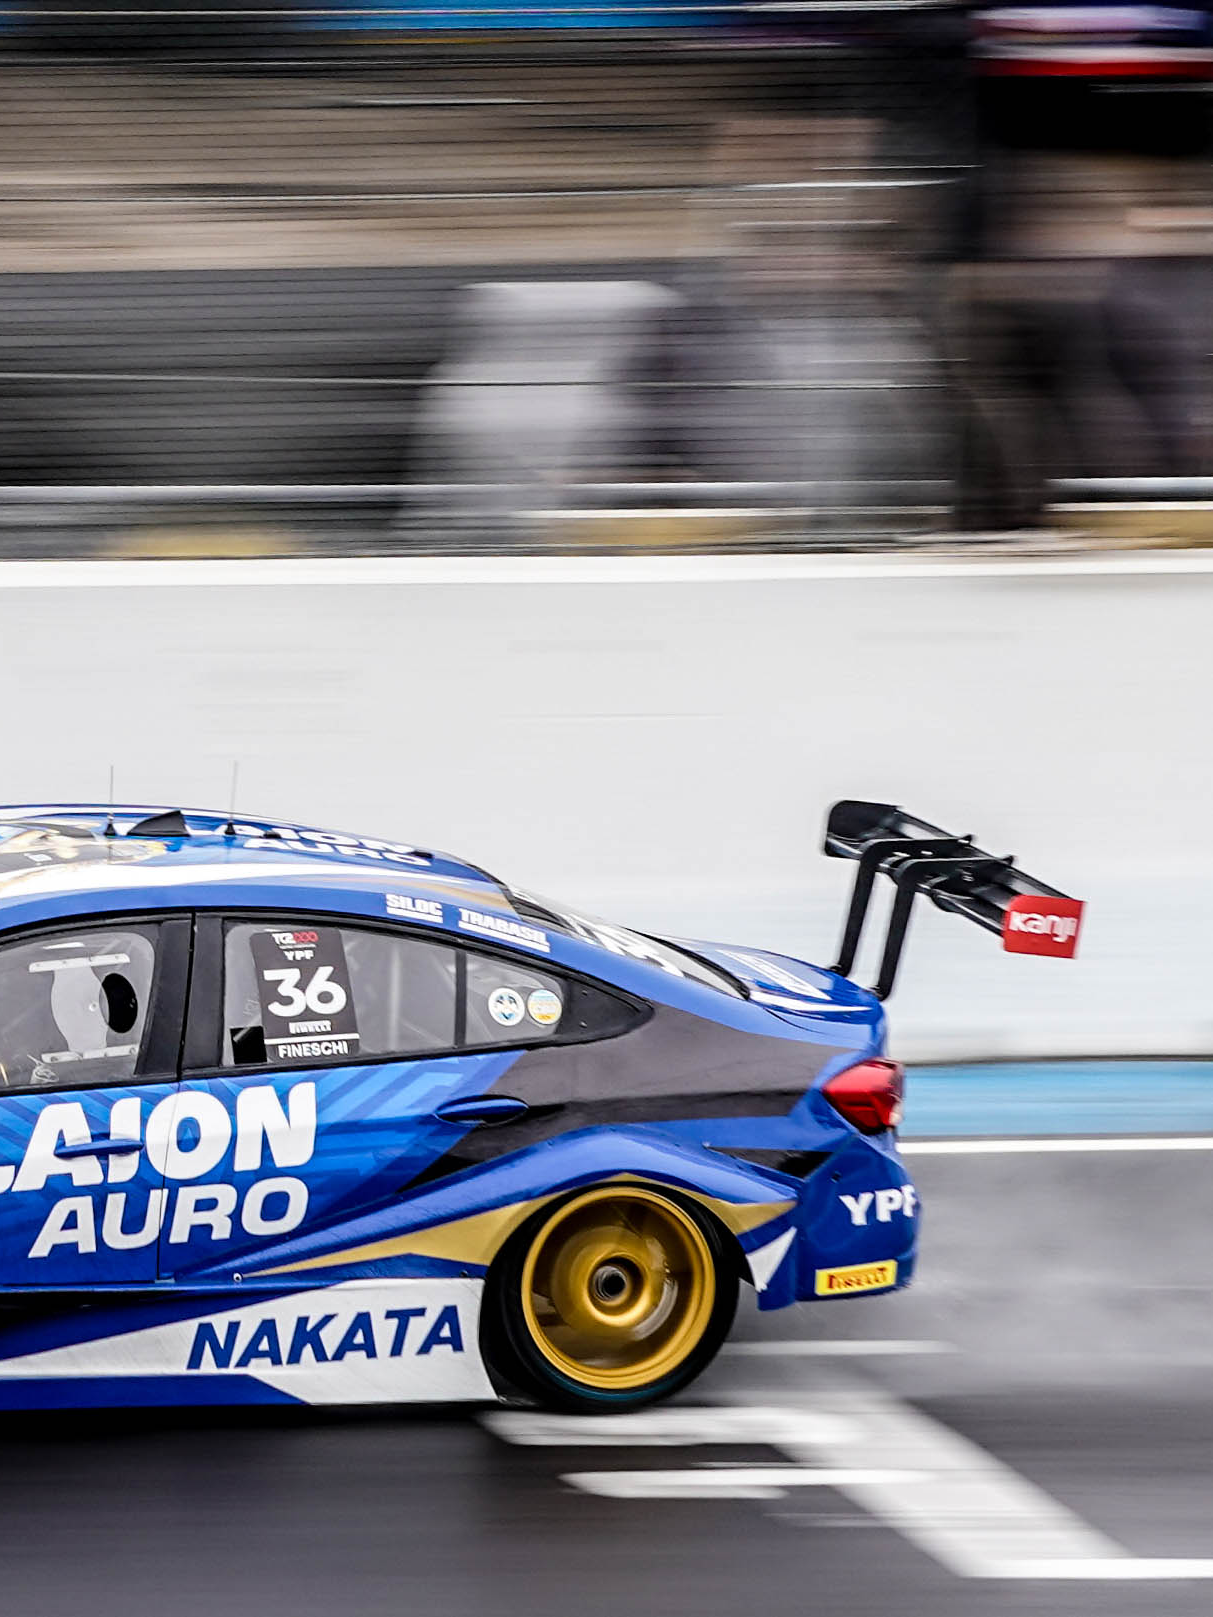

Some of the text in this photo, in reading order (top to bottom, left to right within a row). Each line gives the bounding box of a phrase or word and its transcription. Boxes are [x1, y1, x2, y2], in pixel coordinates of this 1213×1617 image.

[243, 838, 433, 867] AURO
[283, 949, 315, 961] YPF
[263, 965, 347, 1017] 36
[277, 1041, 349, 1059] FINESCHI
[27, 1175, 310, 1259] AURO
[185, 1304, 466, 1372] NAKATA
